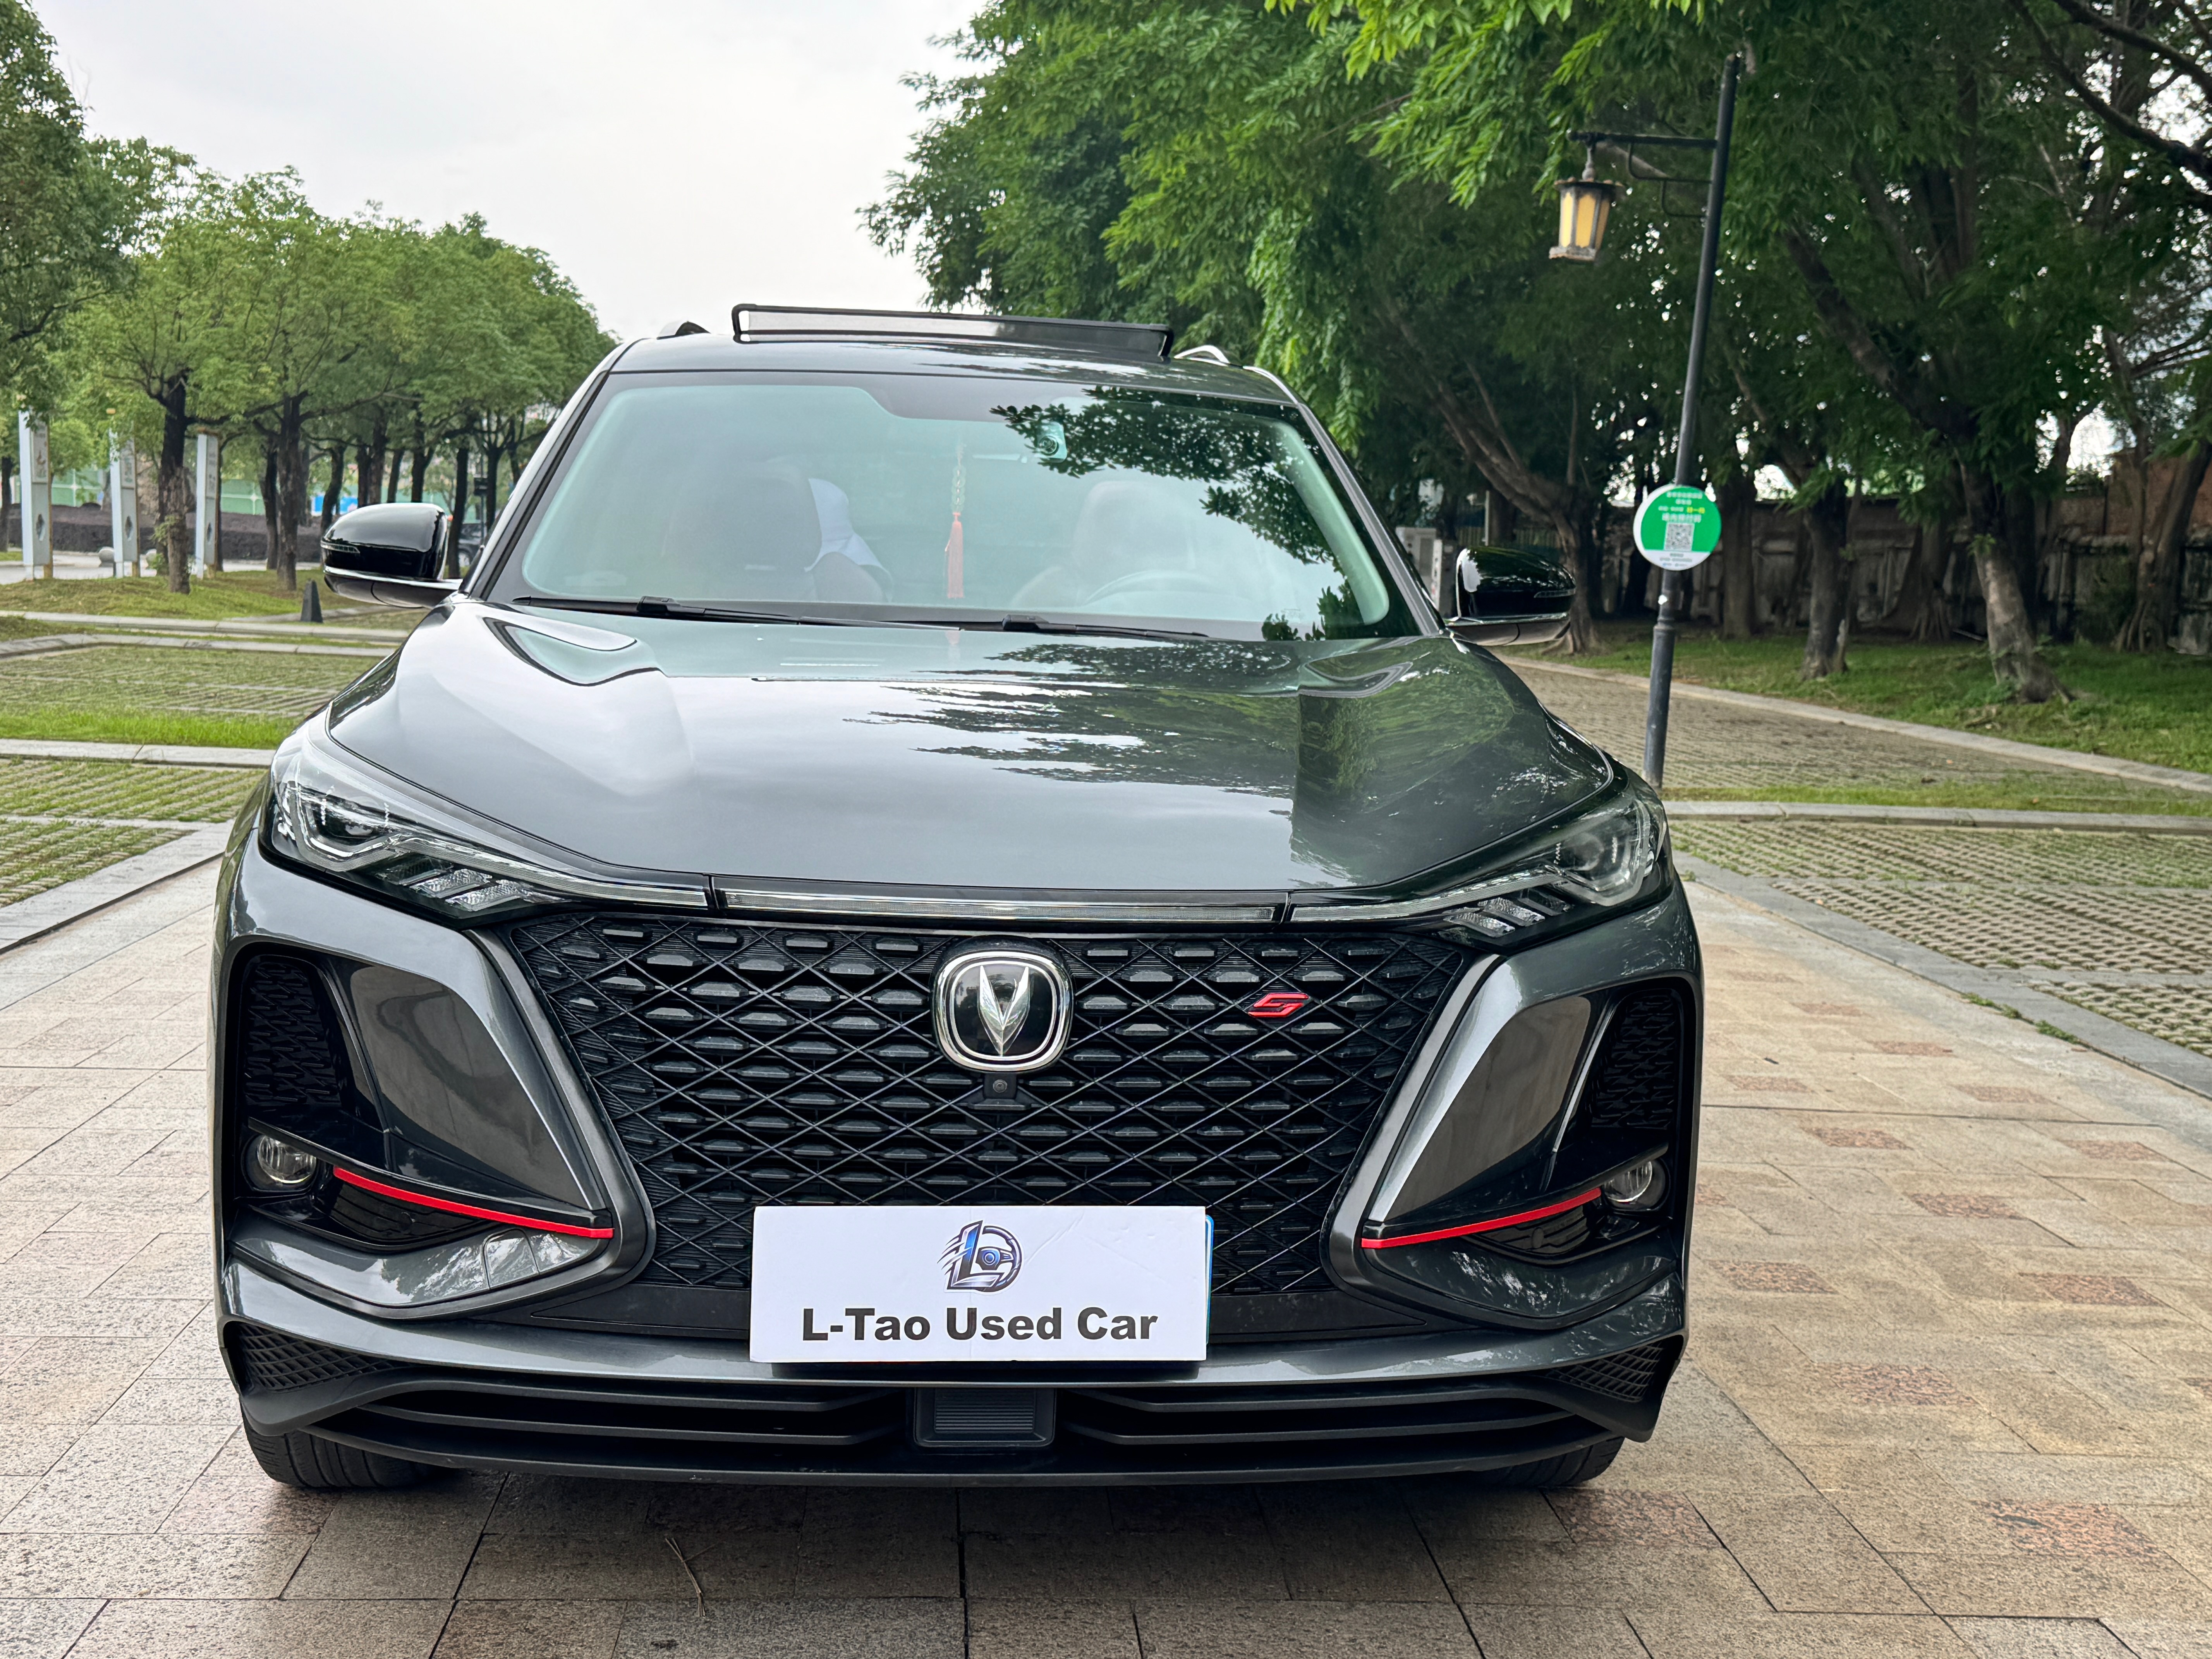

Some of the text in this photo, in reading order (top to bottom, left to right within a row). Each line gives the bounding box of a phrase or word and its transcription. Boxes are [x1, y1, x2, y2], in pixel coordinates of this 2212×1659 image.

[802, 1307, 1159, 1341] L-Tao Used Car
